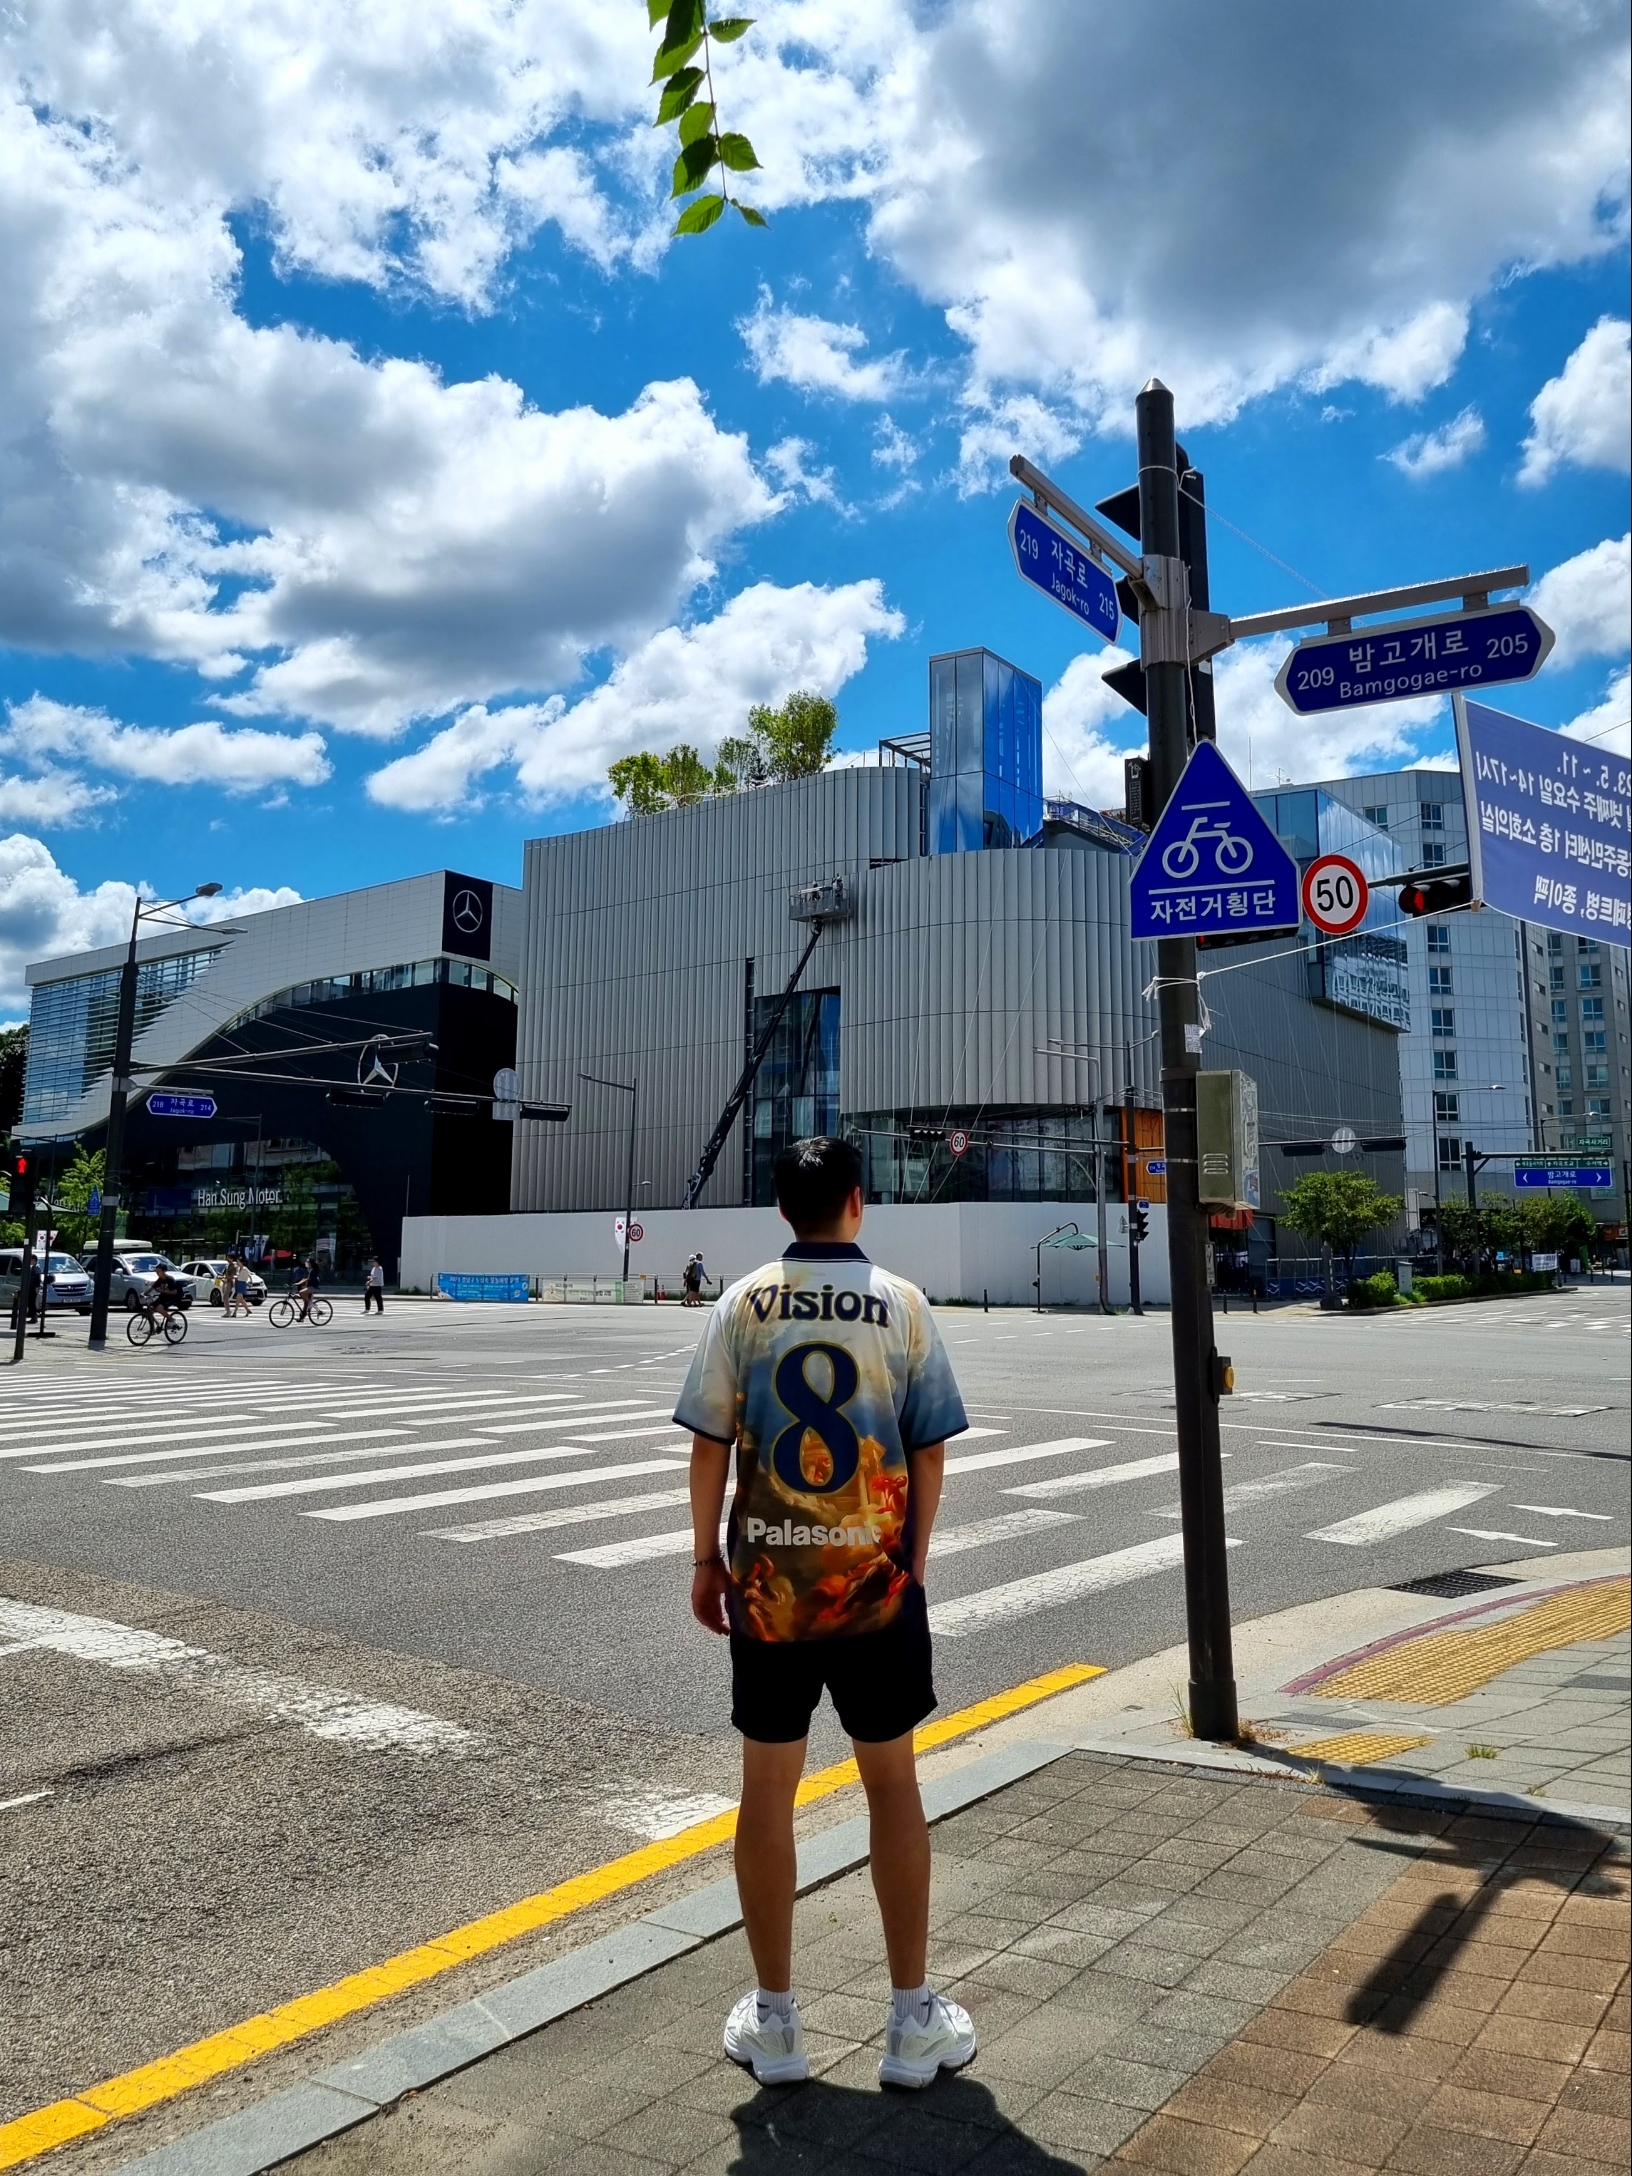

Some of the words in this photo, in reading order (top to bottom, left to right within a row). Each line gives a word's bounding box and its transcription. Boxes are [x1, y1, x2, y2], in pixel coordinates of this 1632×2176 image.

[1020, 529, 1039, 560] 219
[1051, 540, 1088, 589] 자곡로
[1051, 572, 1090, 616] Jagok-ro
[1099, 593, 1115, 621] 215
[1349, 630, 1469, 674] 밤고개로
[1486, 633, 1529, 659] 205
[1297, 667, 1335, 690] 209
[1339, 664, 1482, 699] Bamgogae-ro
[1150, 889, 1276, 925] 자전거횡단
[1316, 875, 1354, 912] 50
[170, 1098, 195, 1107] 자곡로
[954, 1136, 965, 1148] 60
[1578, 1138, 1609, 1146] 자곡사거리
[1547, 1170, 1577, 1179] 밤고개로
[198, 1189, 218, 1207] Han
[220, 1188, 246, 1210] Sung
[631, 1228, 641, 1237] 60
[747, 1283, 890, 1329] Vision
[773, 1340, 861, 1495] 8
[747, 1516, 882, 1547] Palasonic
